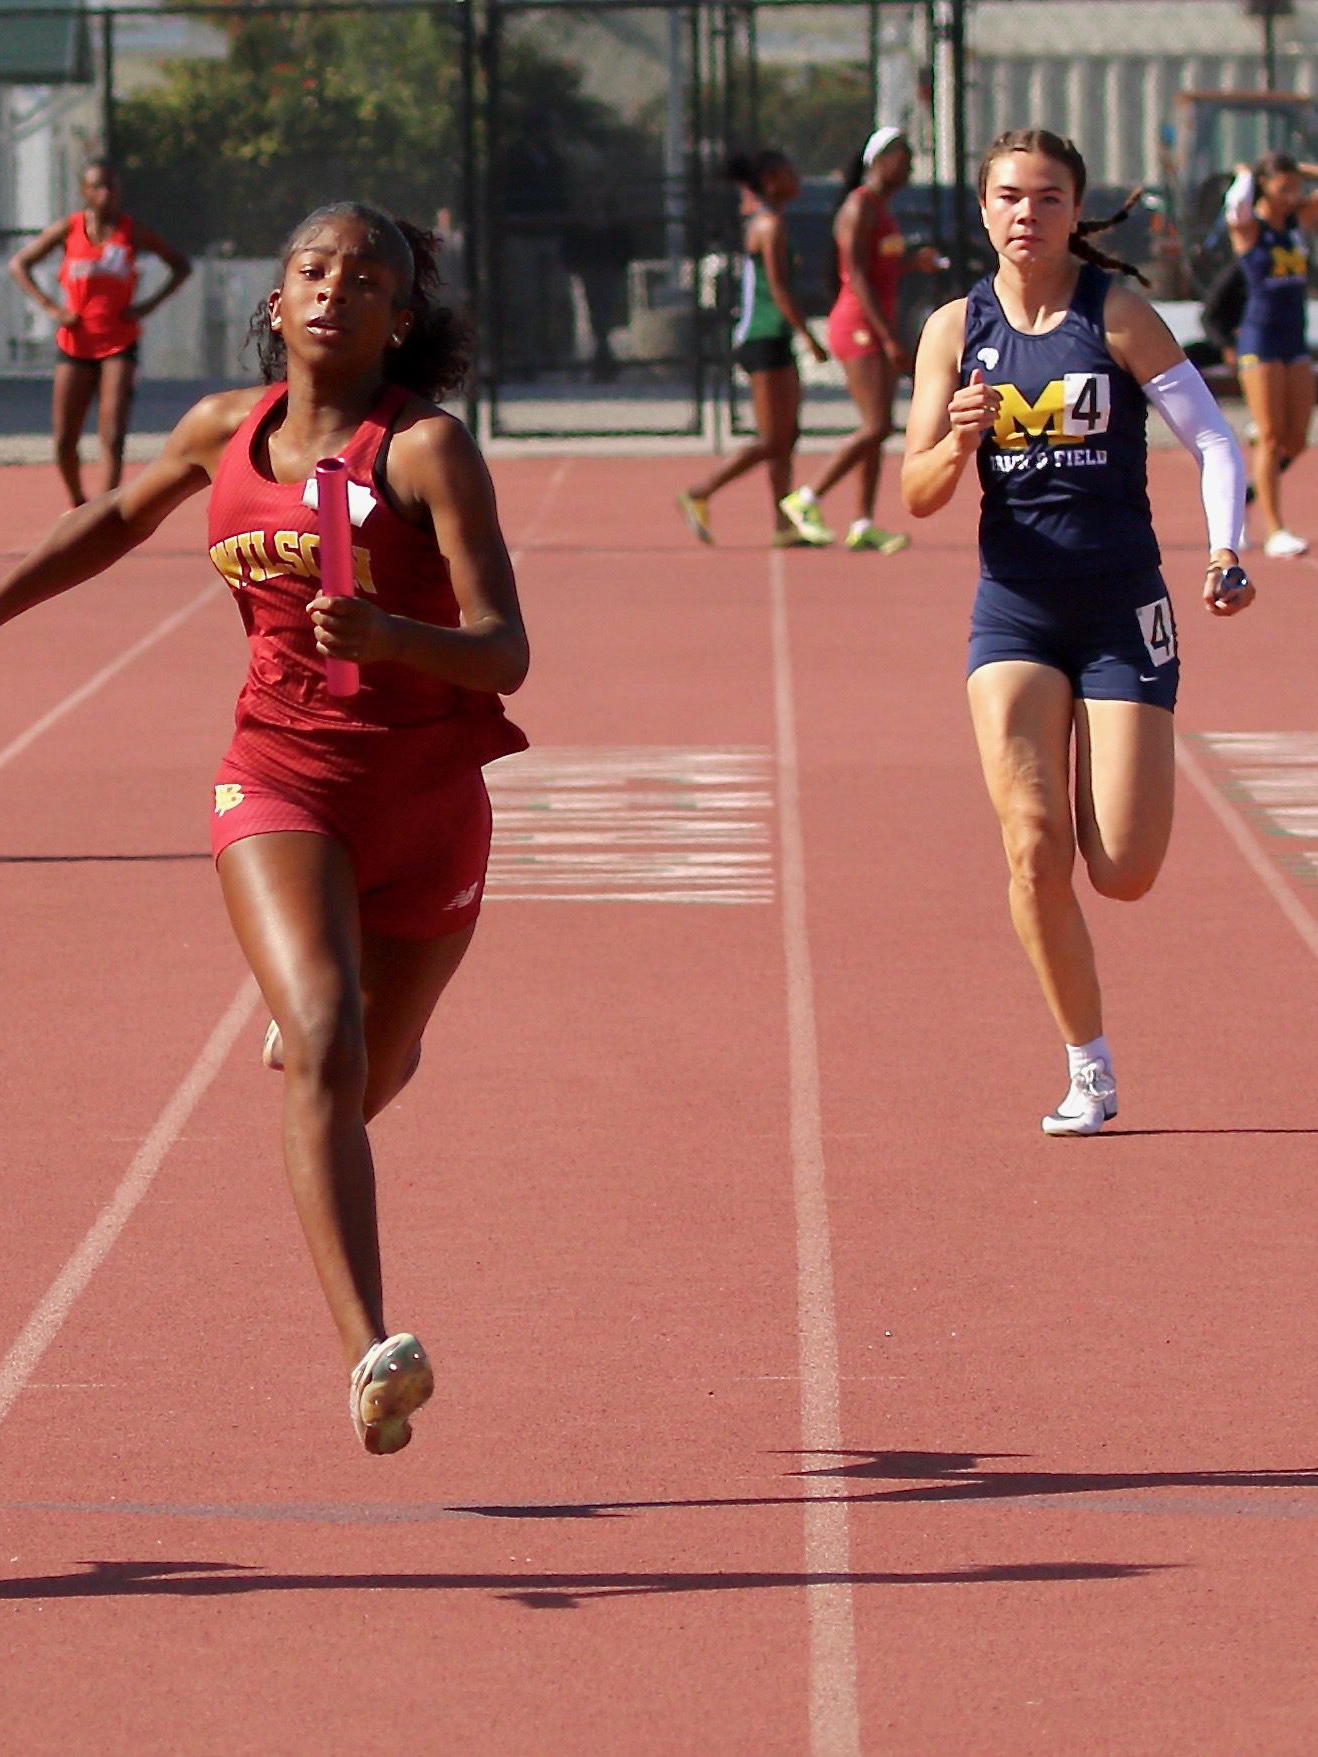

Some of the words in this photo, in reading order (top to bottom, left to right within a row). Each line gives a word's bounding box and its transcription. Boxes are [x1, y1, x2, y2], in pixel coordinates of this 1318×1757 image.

[1072, 377, 1101, 430] 4
[1053, 449, 1108, 468] FIELD
[1151, 604, 1171, 656] 4
